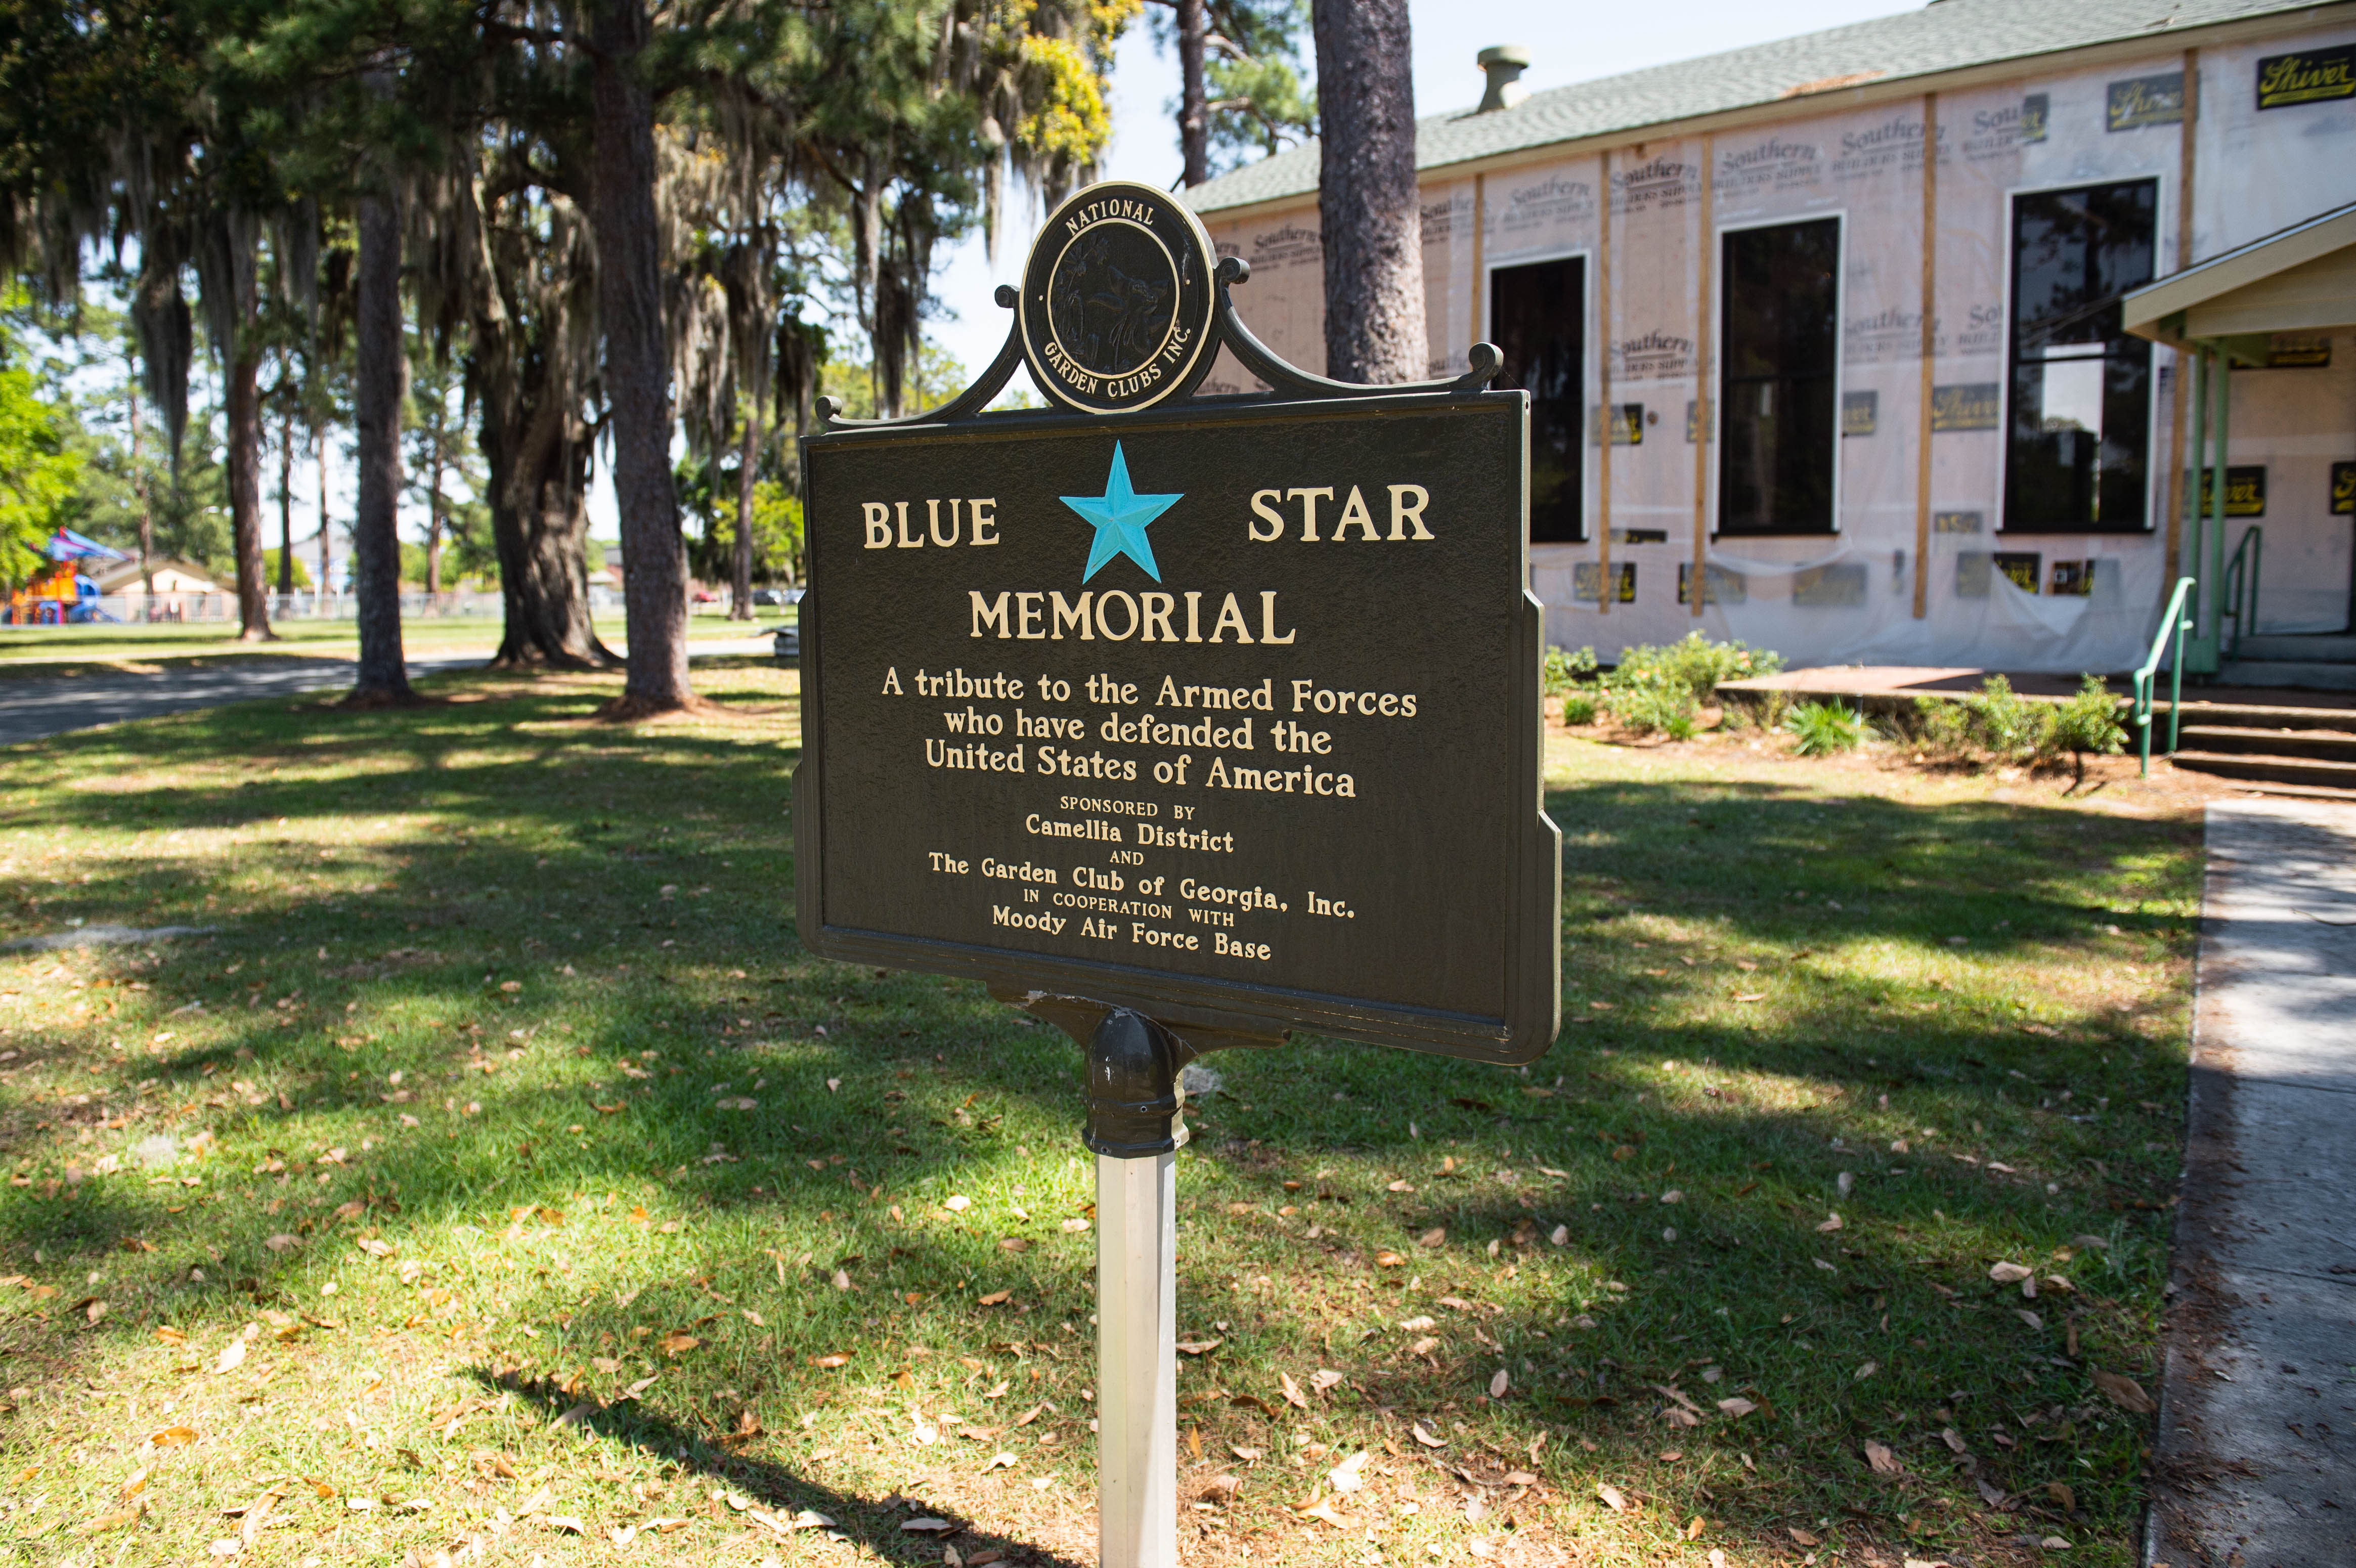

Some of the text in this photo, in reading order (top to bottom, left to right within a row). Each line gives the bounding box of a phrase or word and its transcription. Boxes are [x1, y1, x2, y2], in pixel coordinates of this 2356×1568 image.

[2259, 57, 2349, 93] Shiver
[1065, 198, 1154, 237] NATIONAL
[1044, 327, 1192, 398] GARDEN CLUBS INC.
[861, 484, 1435, 549] BLUE STAR
[968, 589, 1296, 644] MEMORIAL
[881, 666, 1417, 718] A tribute to the Armed Forces
[943, 705, 1332, 755] who have defended the
[925, 738, 1357, 798] United States of America
[1025, 813, 1234, 853] Camellia District
[1060, 795, 1196, 820] SPONSORED BY
[1109, 849, 1145, 866] AND
[928, 851, 1355, 919] The Garden Club of Georgia, Inc.
[1023, 888, 1235, 928] IN COOPERATION WITH
[992, 904, 1272, 961] Moody Air Force Base
